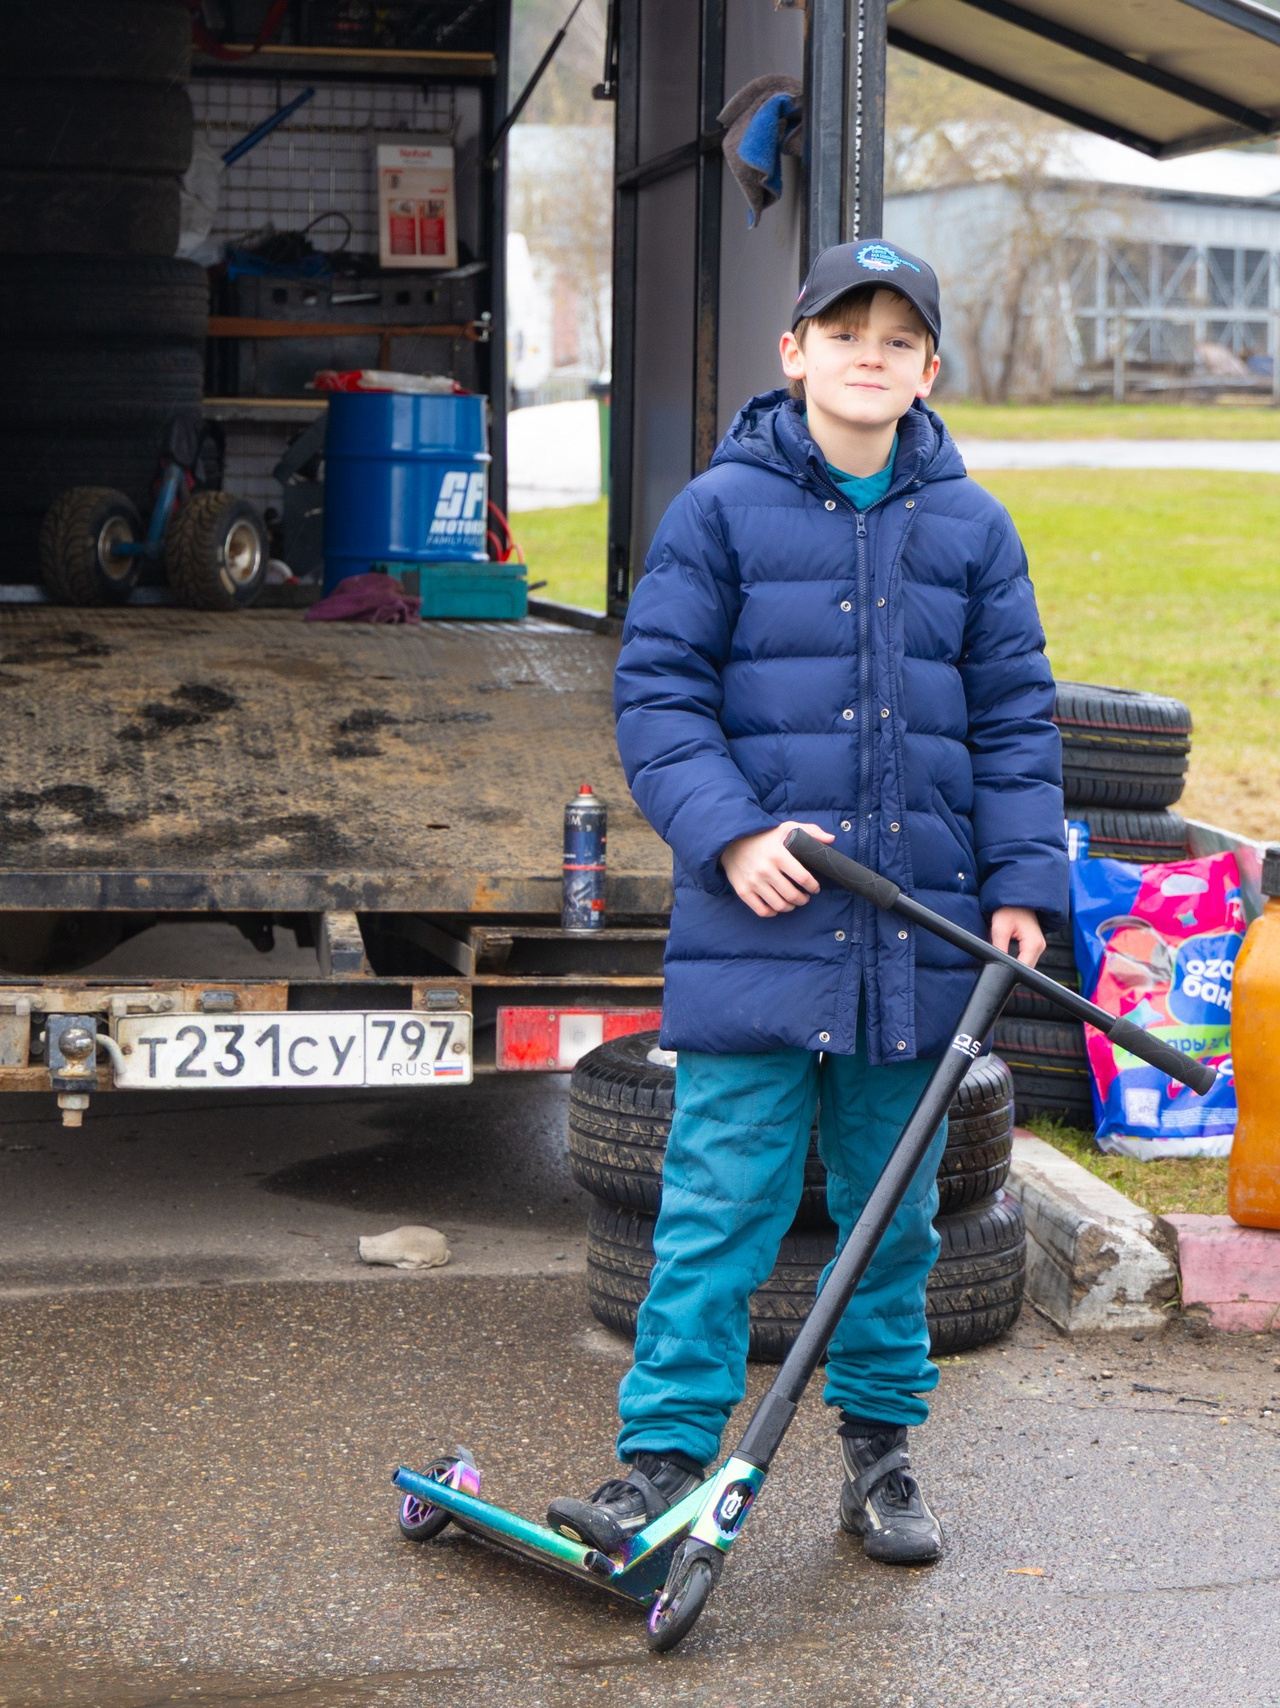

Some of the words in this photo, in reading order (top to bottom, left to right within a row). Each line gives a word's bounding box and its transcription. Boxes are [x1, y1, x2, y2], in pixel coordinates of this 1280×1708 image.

[1186, 959, 1234, 981] ozo
[1182, 974, 1232, 1012] бан
[371, 1020, 455, 1061] 797
[391, 1062, 432, 1077] RUS
